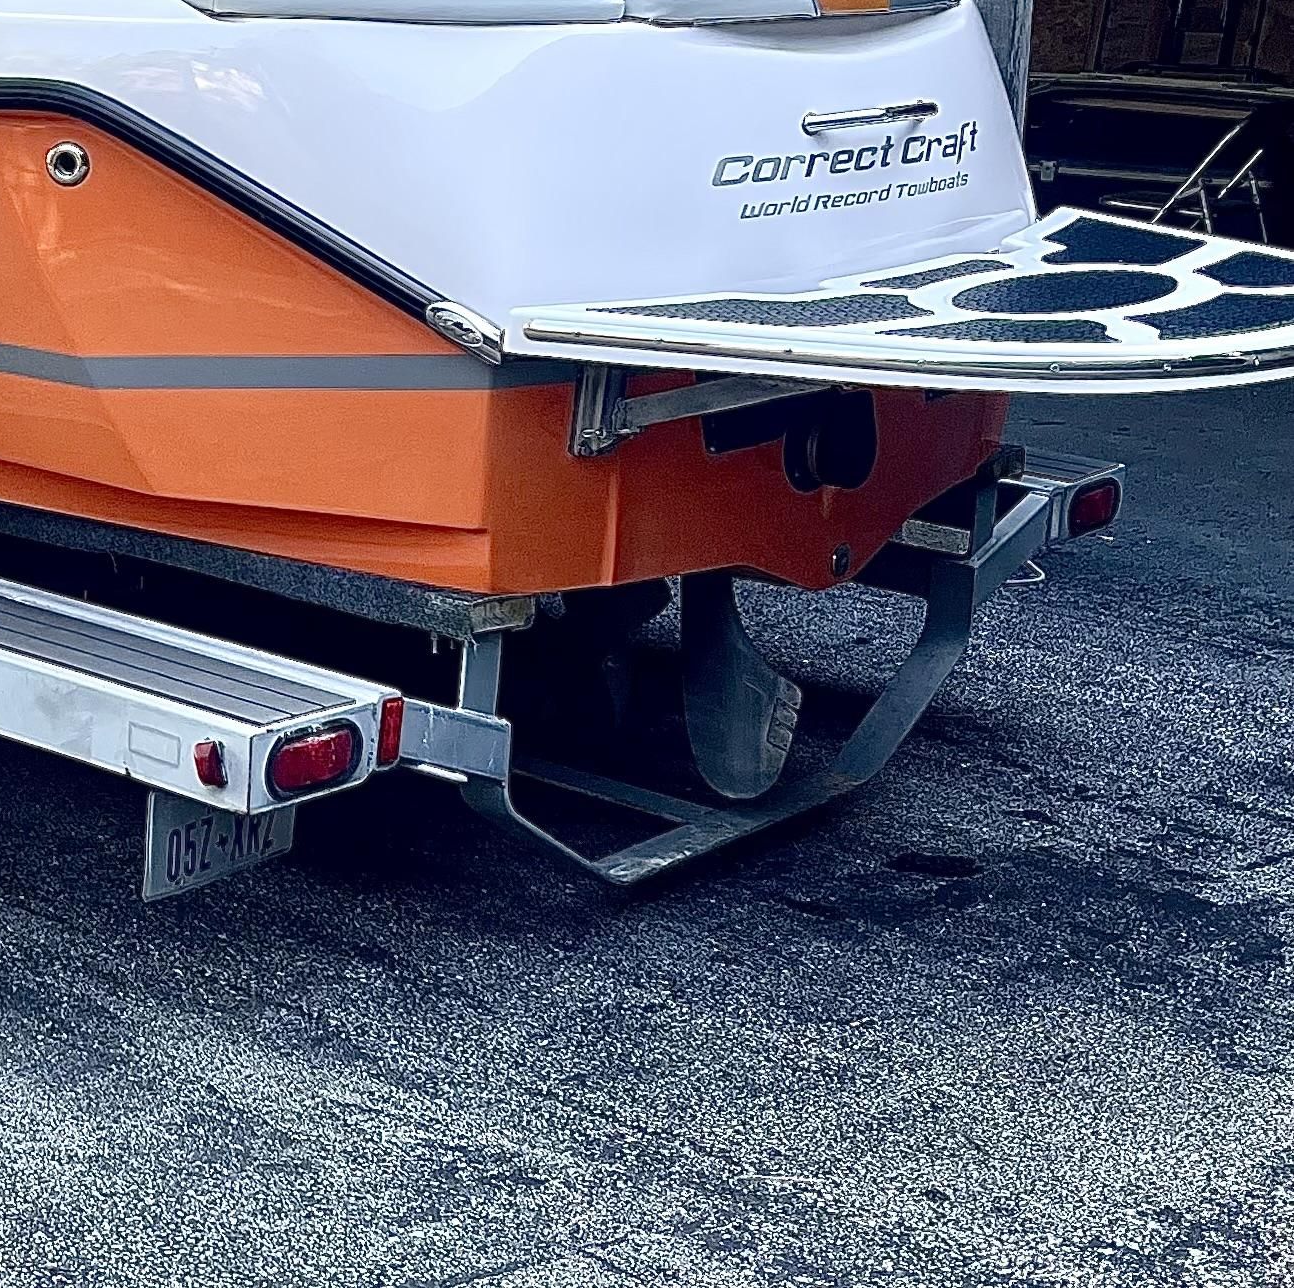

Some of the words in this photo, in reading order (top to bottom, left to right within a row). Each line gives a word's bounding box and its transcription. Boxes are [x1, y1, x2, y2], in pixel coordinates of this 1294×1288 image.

[711, 134, 895, 187] Correct
[900, 120, 979, 165] Craft
[739, 194, 811, 220] World
[813, 183, 893, 211] Record
[896, 171, 970, 199] Towboats
